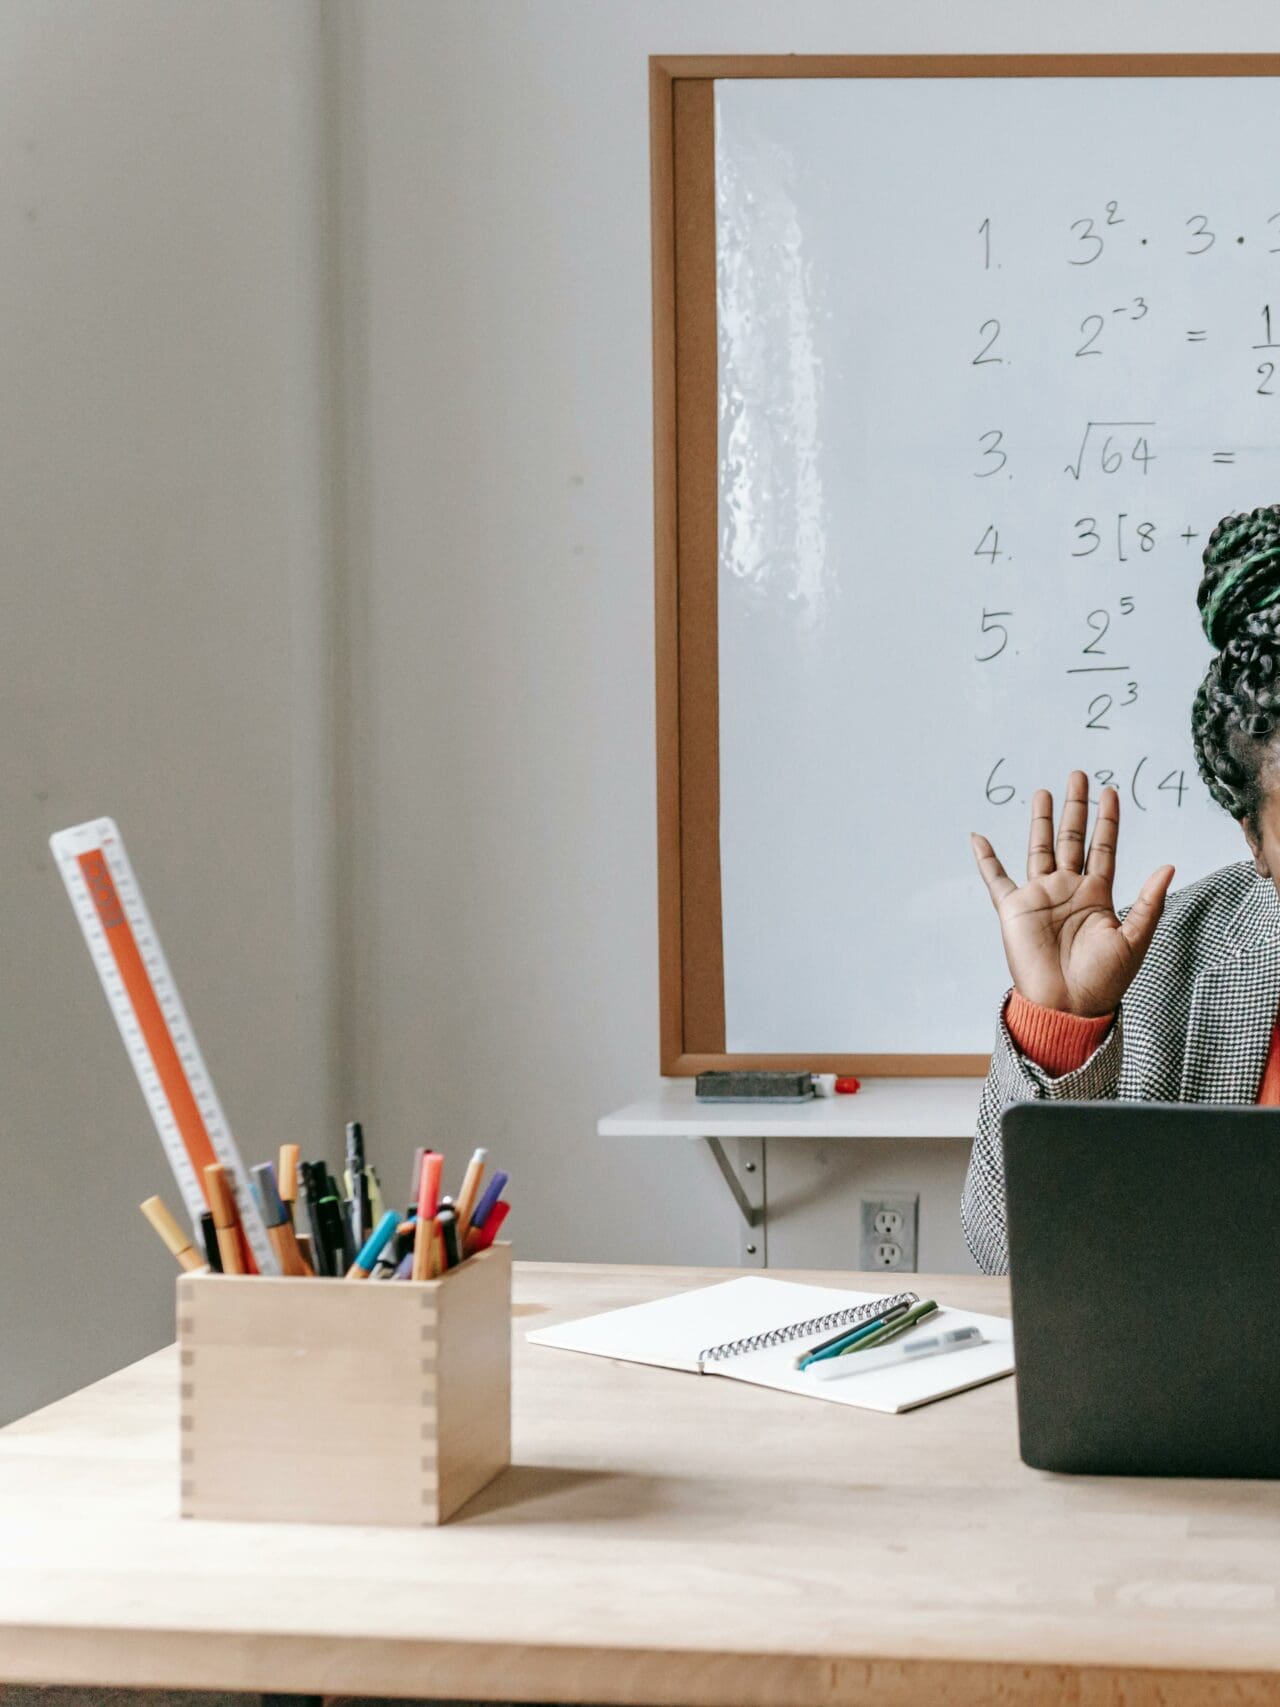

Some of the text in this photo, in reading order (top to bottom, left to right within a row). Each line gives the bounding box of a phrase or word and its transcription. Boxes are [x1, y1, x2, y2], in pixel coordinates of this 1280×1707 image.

[976, 217, 1002, 271] 1.
[1185, 214, 1216, 256] 3
[972, 318, 1012, 366] 2.
[973, 429, 1014, 480] 3.
[973, 524, 1013, 565] 4.
[974, 607, 1020, 663] 5.
[984, 757, 1026, 806] 6.
